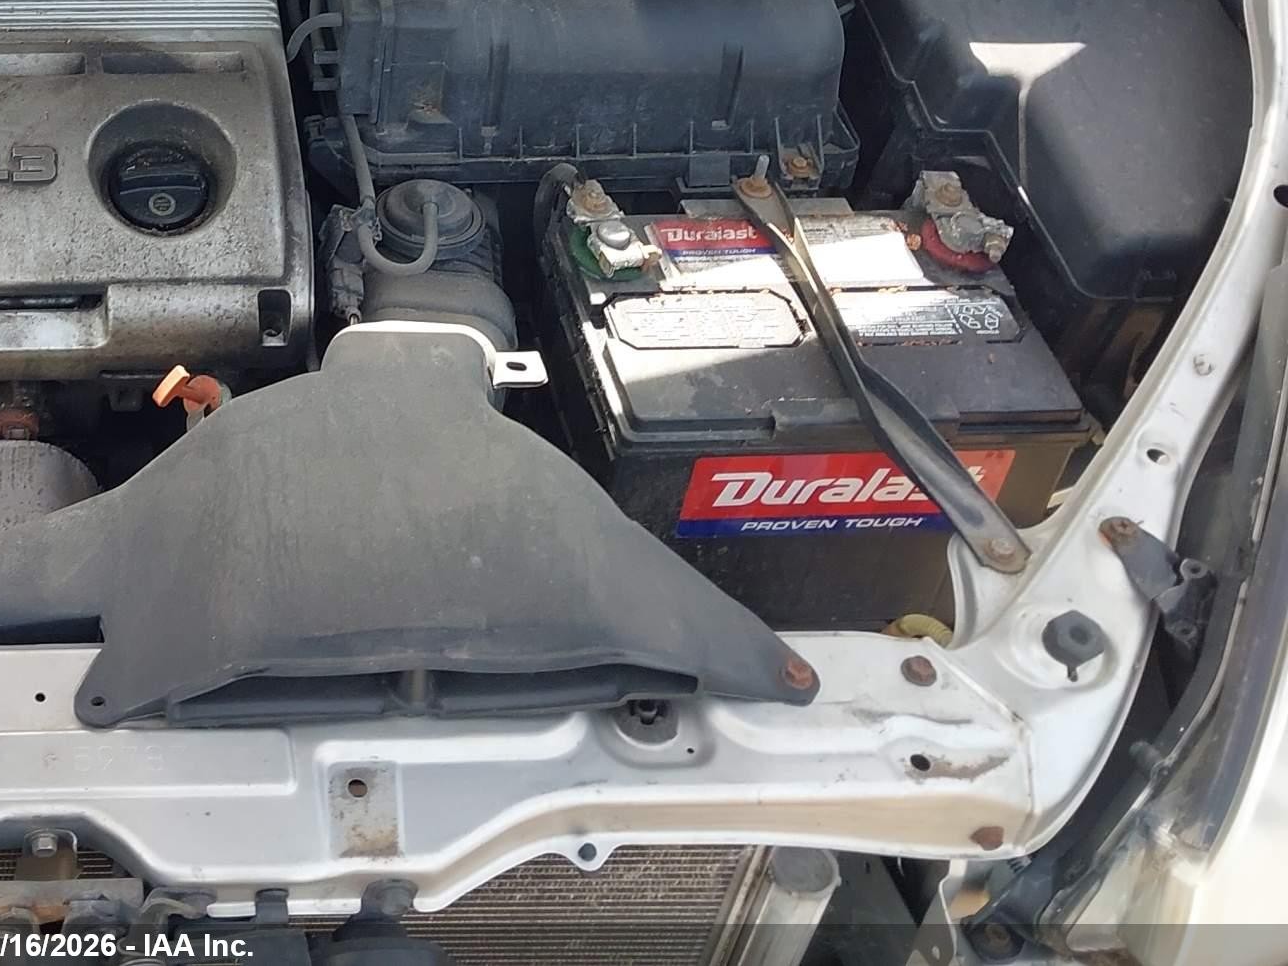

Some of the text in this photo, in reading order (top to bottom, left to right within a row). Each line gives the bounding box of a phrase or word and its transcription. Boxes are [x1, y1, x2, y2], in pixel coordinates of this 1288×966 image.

[661, 226, 757, 242] Duralast
[741, 516, 923, 531] PROVEN TOUGH
